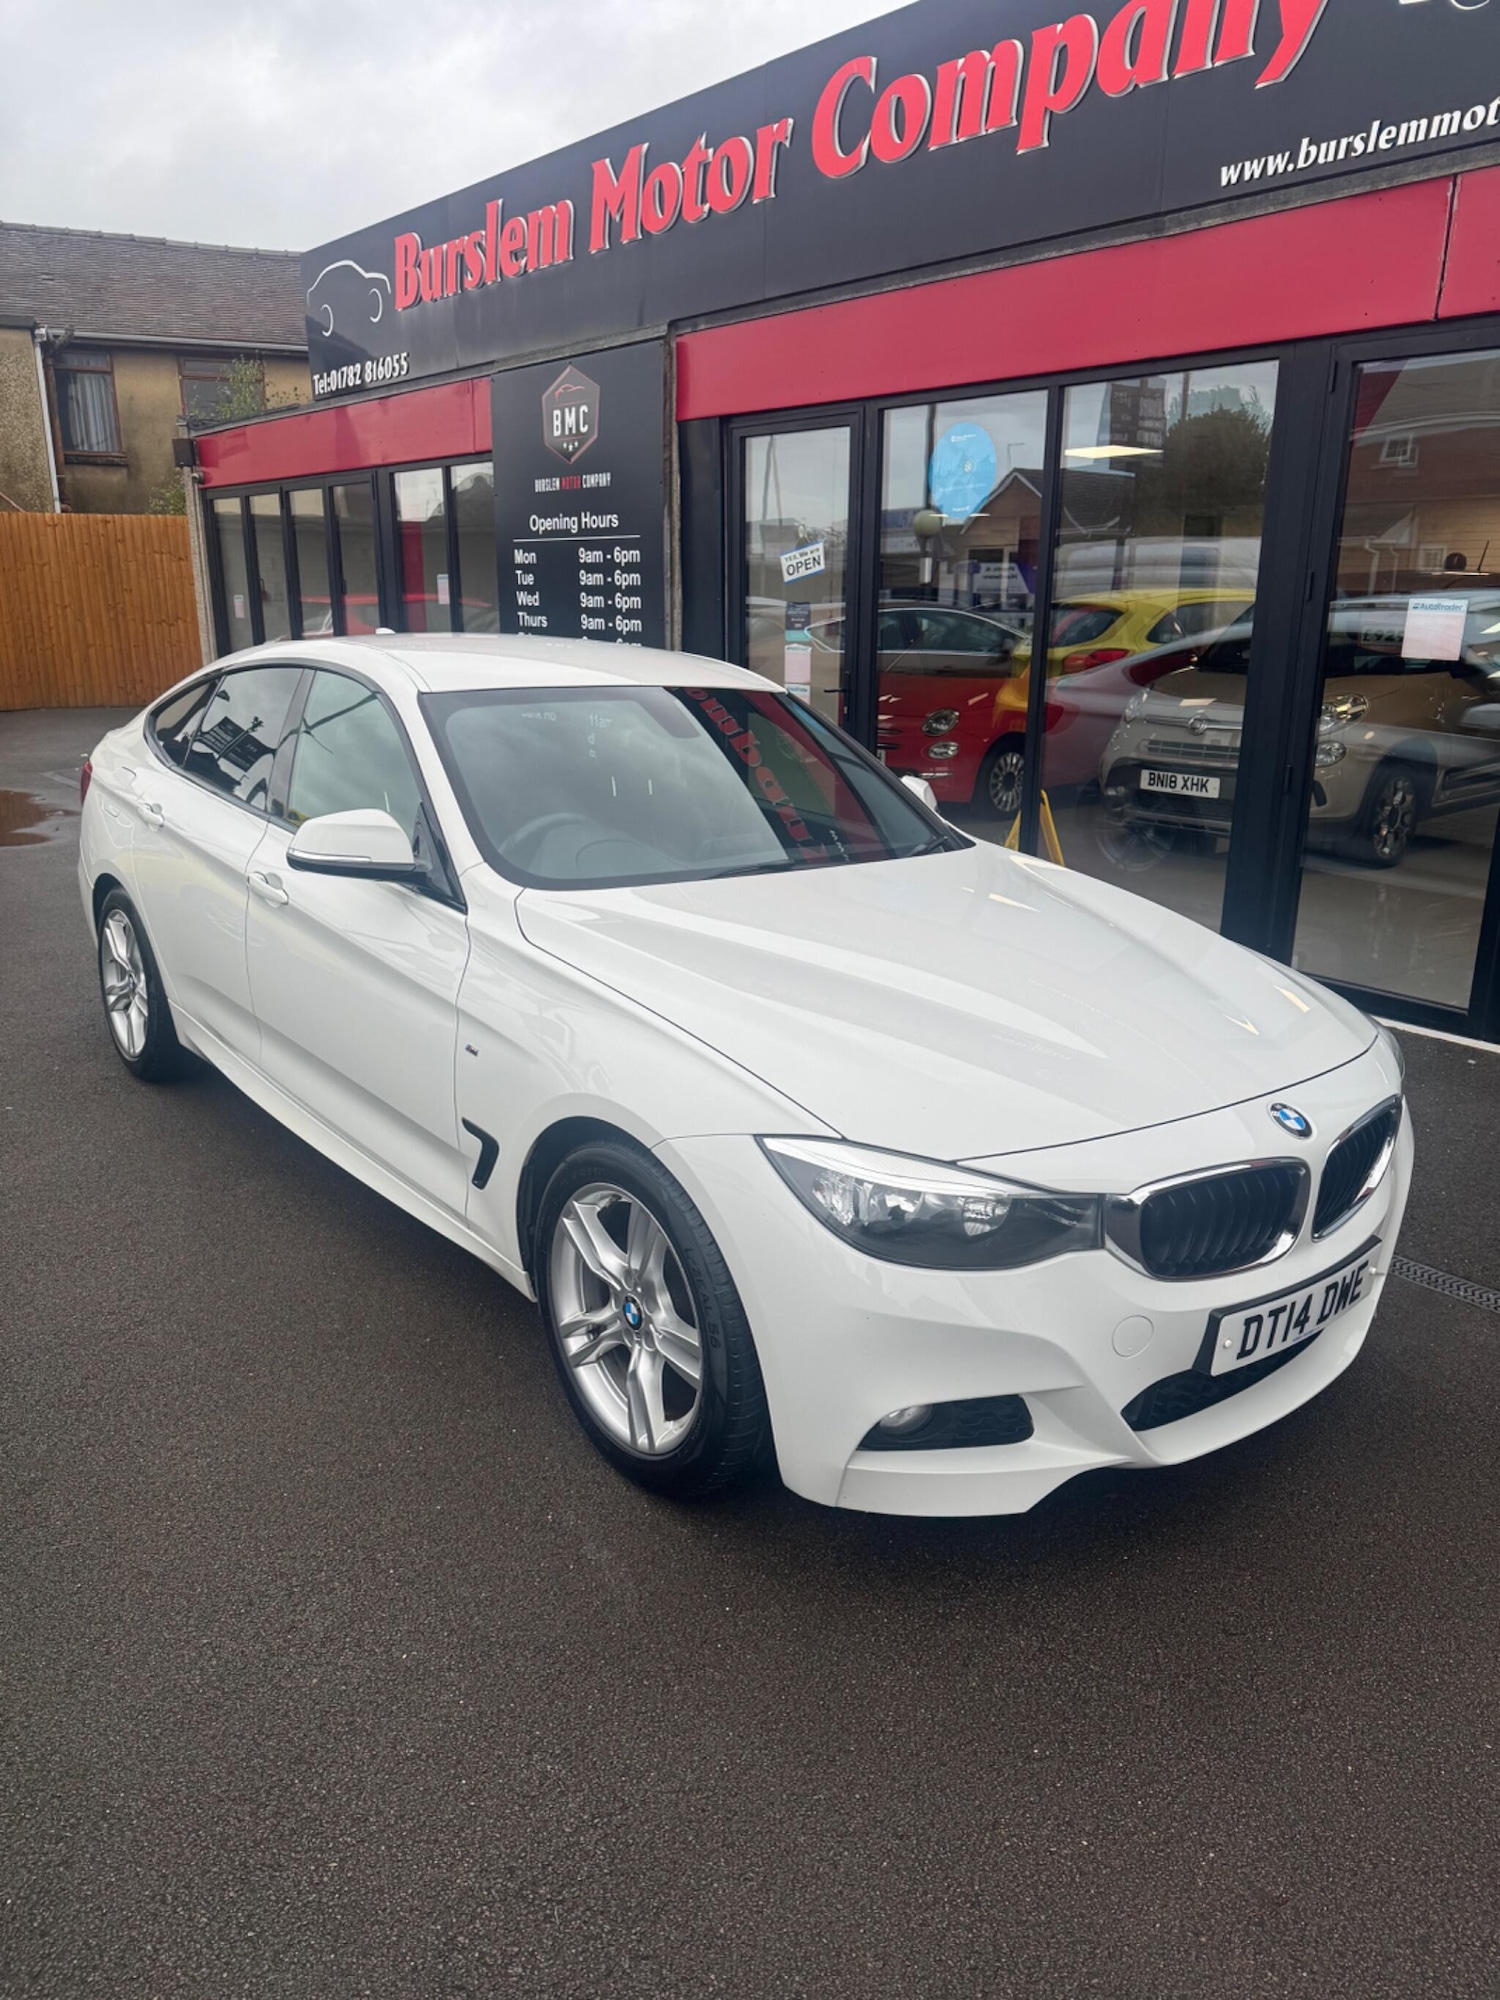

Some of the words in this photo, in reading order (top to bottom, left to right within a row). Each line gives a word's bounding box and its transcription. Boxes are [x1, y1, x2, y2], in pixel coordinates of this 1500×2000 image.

[1220, 96, 1500, 188] www.burslemmot
[394, 199, 574, 311] Burslem
[588, 118, 794, 255] Motor
[313, 363, 361, 395] Tel:01782
[365, 352, 408, 382] 816055
[552, 404, 589, 437] BMC
[529, 514, 578, 533] Opening
[580, 512, 619, 529] Hours
[514, 549, 537, 564] Mon
[578, 547, 603, 563] 9am
[613, 546, 640, 567] 6pm
[786, 554, 821, 576] OPEN
[515, 570, 535, 585] Tue
[579, 570, 604, 586] 9am
[614, 569, 641, 590] 6pm
[516, 592, 540, 607] Wed
[580, 592, 605, 608] 9am
[614, 592, 642, 613] 6pm
[517, 612, 548, 628] Thurs
[580, 615, 605, 631] 9am
[615, 615, 642, 636] 6pm
[1148, 771, 1178, 789] BN18
[1181, 775, 1210, 793] XHK
[1236, 1294, 1314, 1360] DT14
[1316, 1260, 1369, 1326] DWE
